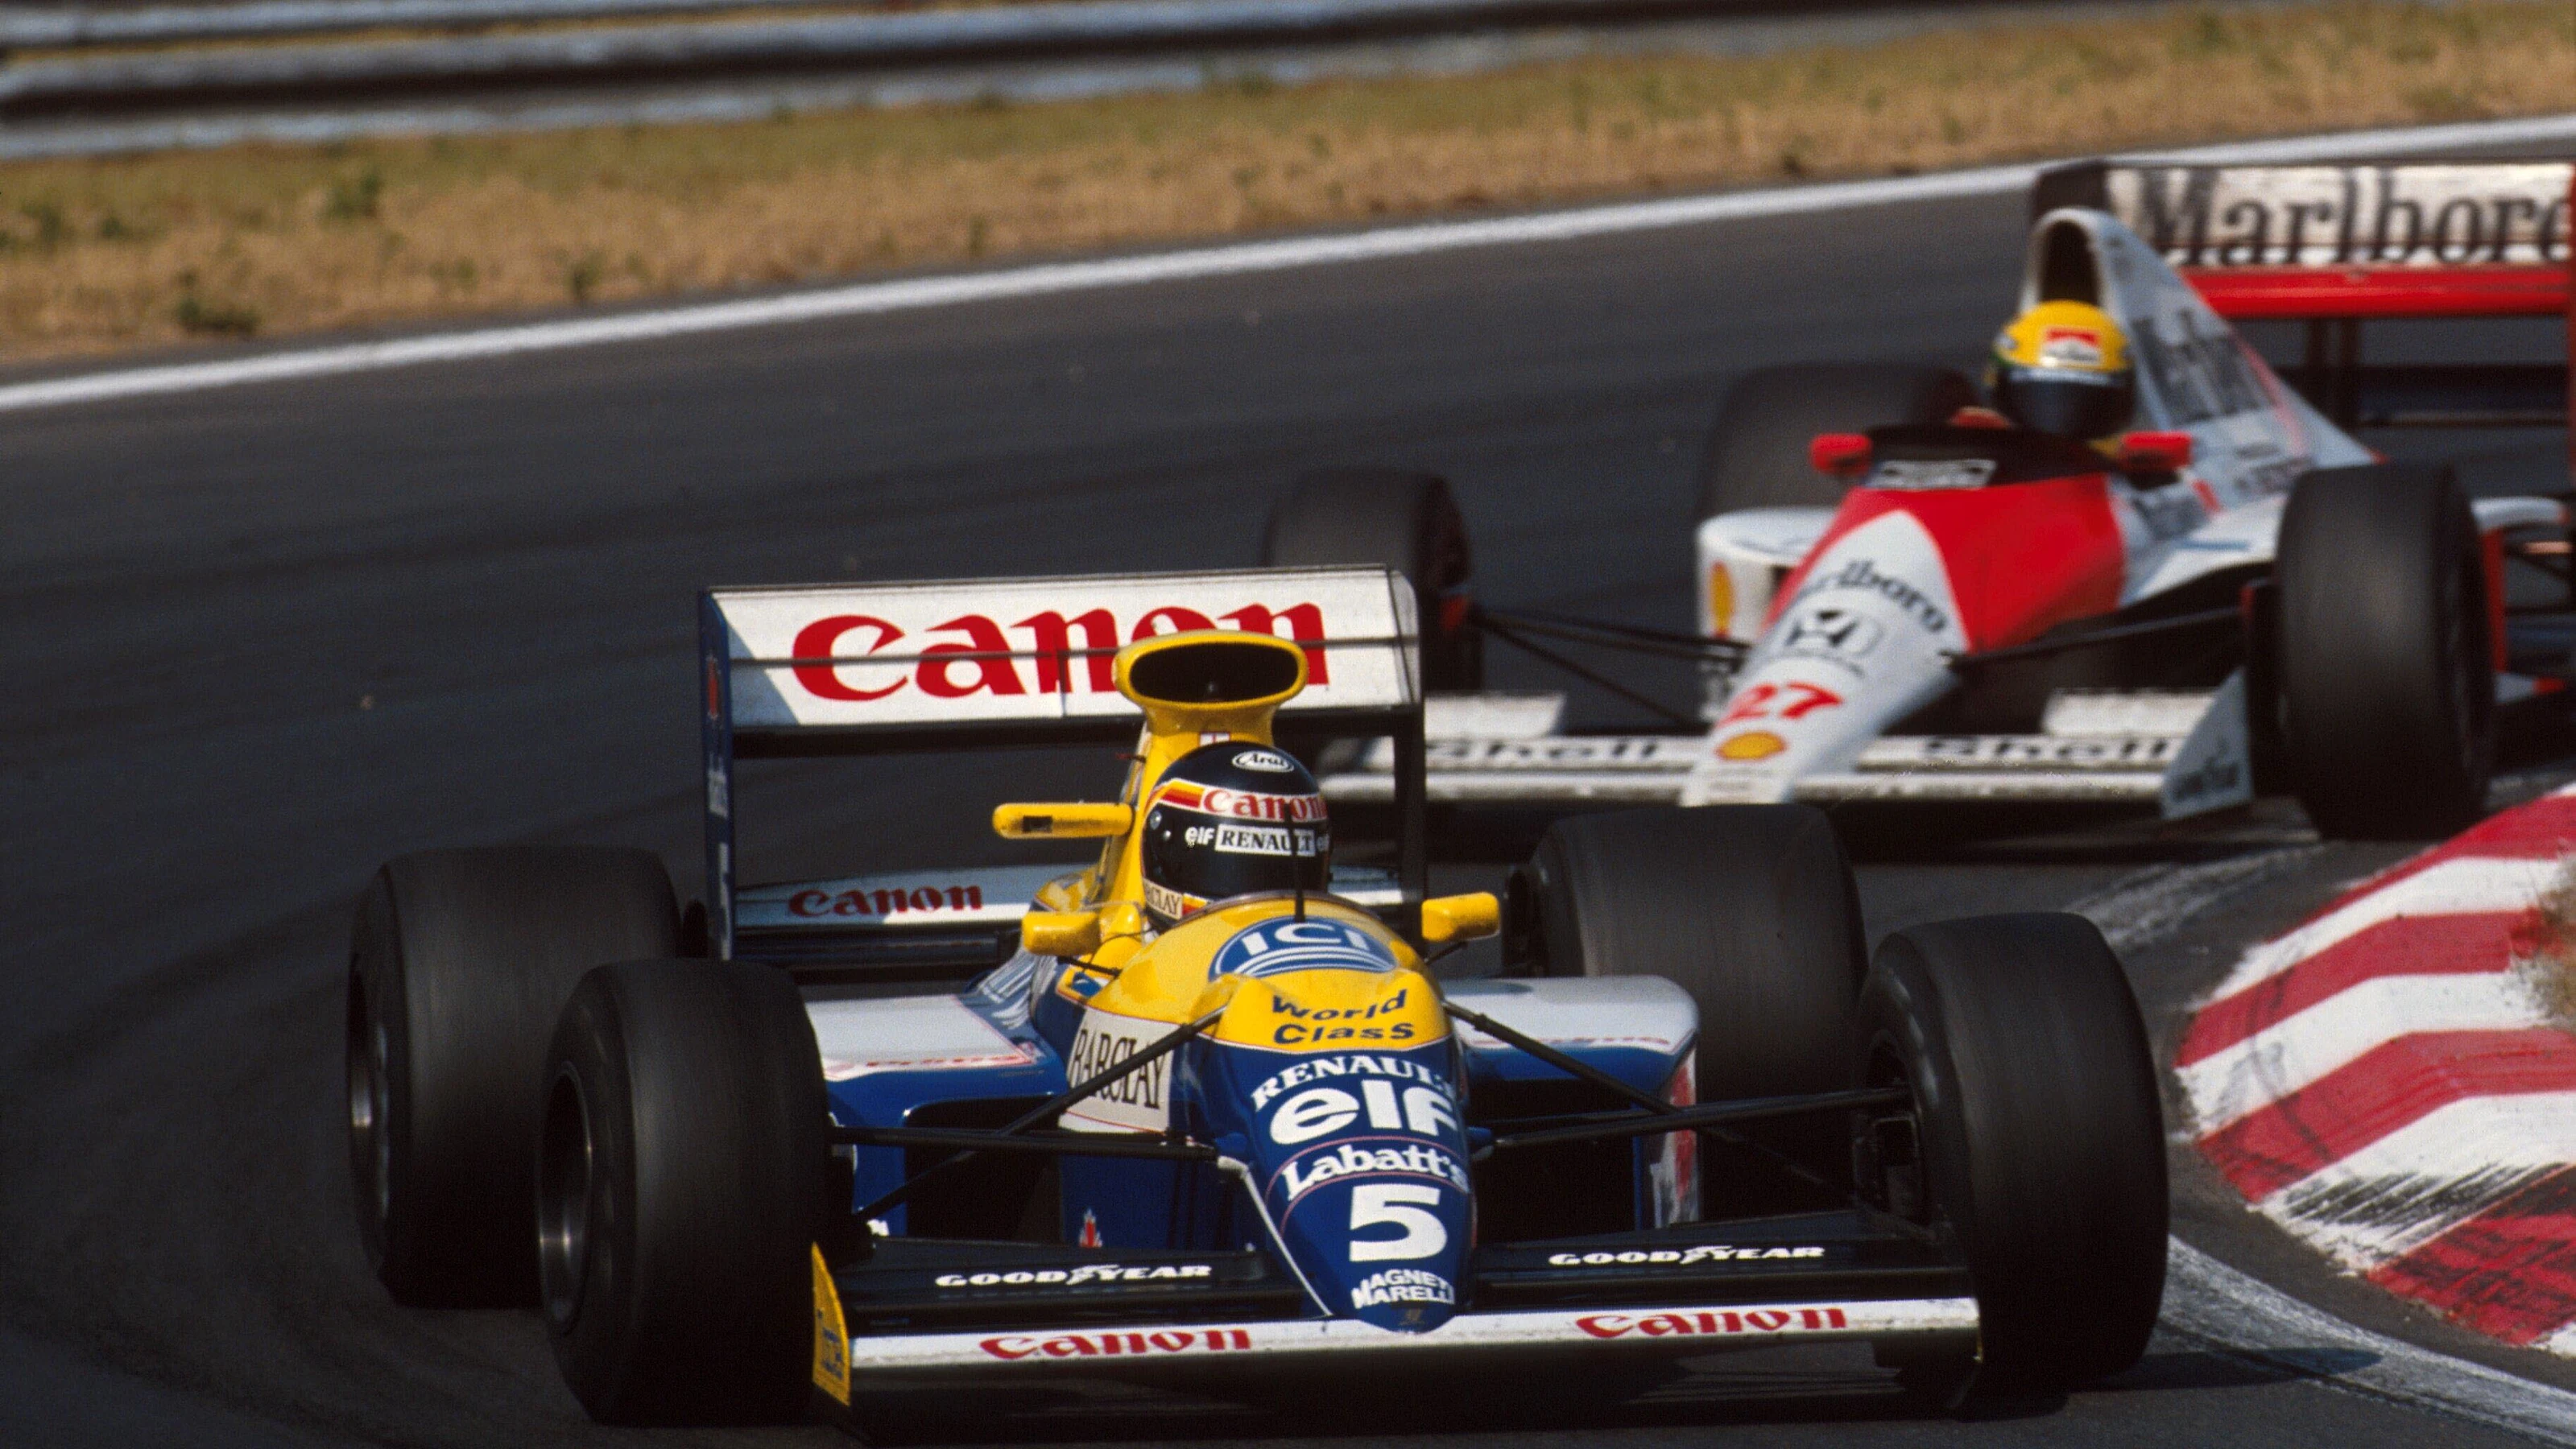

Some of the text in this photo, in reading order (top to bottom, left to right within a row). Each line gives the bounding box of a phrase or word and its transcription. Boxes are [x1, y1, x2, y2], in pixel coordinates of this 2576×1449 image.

[1717, 681, 1844, 727] 27
[1241, 751, 1286, 766] Arai
[1927, 735, 2169, 758] Shell
[1203, 789, 1328, 822] Canon
[1185, 826, 1215, 845] elf
[789, 885, 983, 917] Canon
[1241, 923, 1368, 956] ICI
[1271, 989, 1408, 1022] World
[1272, 1021, 1416, 1046] Class
[1270, 1078, 1458, 1145] elf
[1349, 1183, 1448, 1262] 5
[1576, 1307, 1846, 1339] Canon
[980, 1329, 1251, 1360] Canon
